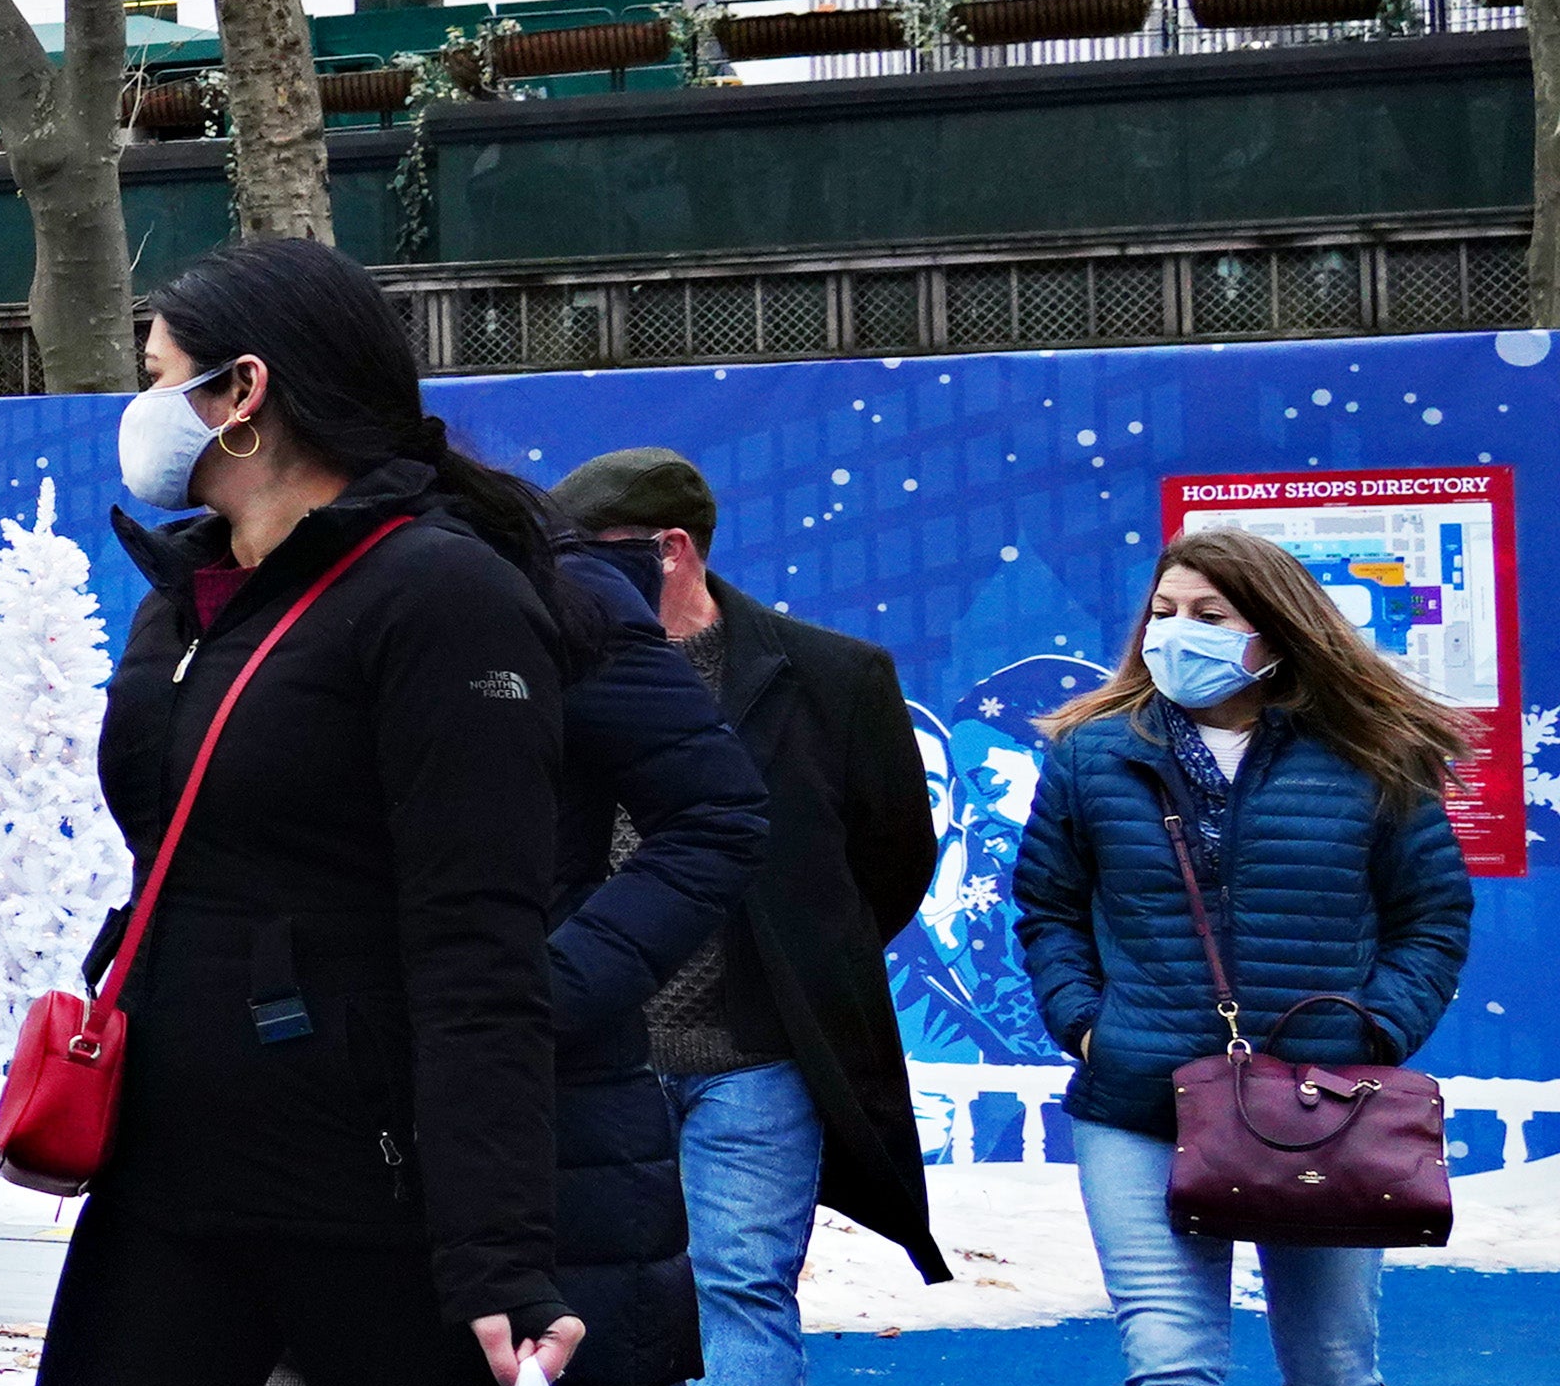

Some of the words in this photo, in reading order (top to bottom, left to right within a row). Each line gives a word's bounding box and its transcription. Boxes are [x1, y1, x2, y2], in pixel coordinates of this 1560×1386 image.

[1182, 482, 1281, 502] HOLIDAY
[1284, 480, 1357, 498] SHOPS
[1361, 476, 1490, 496] DIRECTORY
[486, 670, 510, 680] THE
[469, 680, 511, 690] NORTH
[483, 689, 512, 699] FACE
